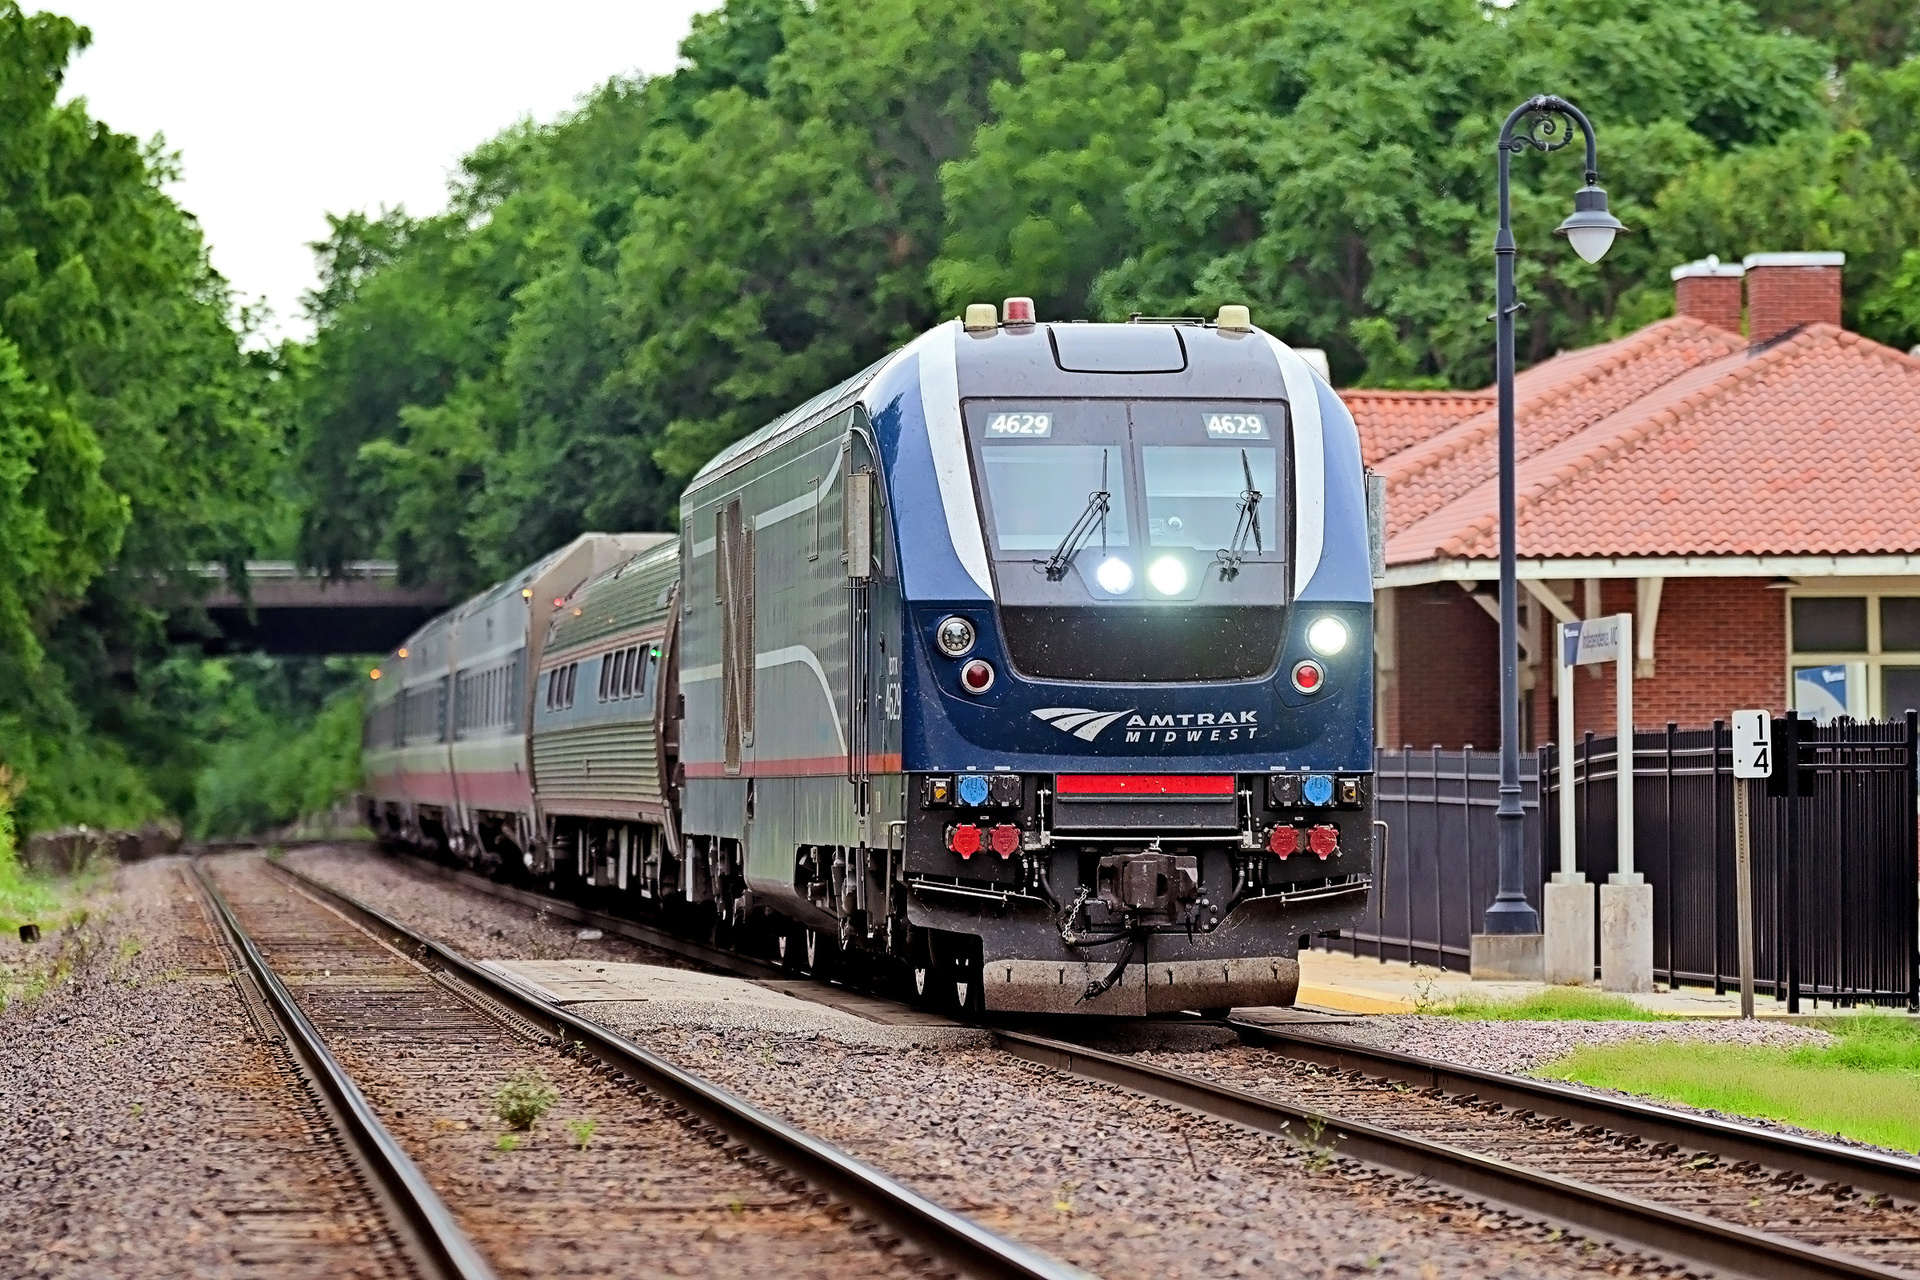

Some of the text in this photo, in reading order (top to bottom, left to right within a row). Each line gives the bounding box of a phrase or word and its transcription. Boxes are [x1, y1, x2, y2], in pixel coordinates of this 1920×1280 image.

[991, 415, 1049, 434] 4629
[1209, 416, 1261, 434] 4629
[1126, 710, 1258, 727] AMTRAK
[1125, 728, 1258, 743] MIDWEST
